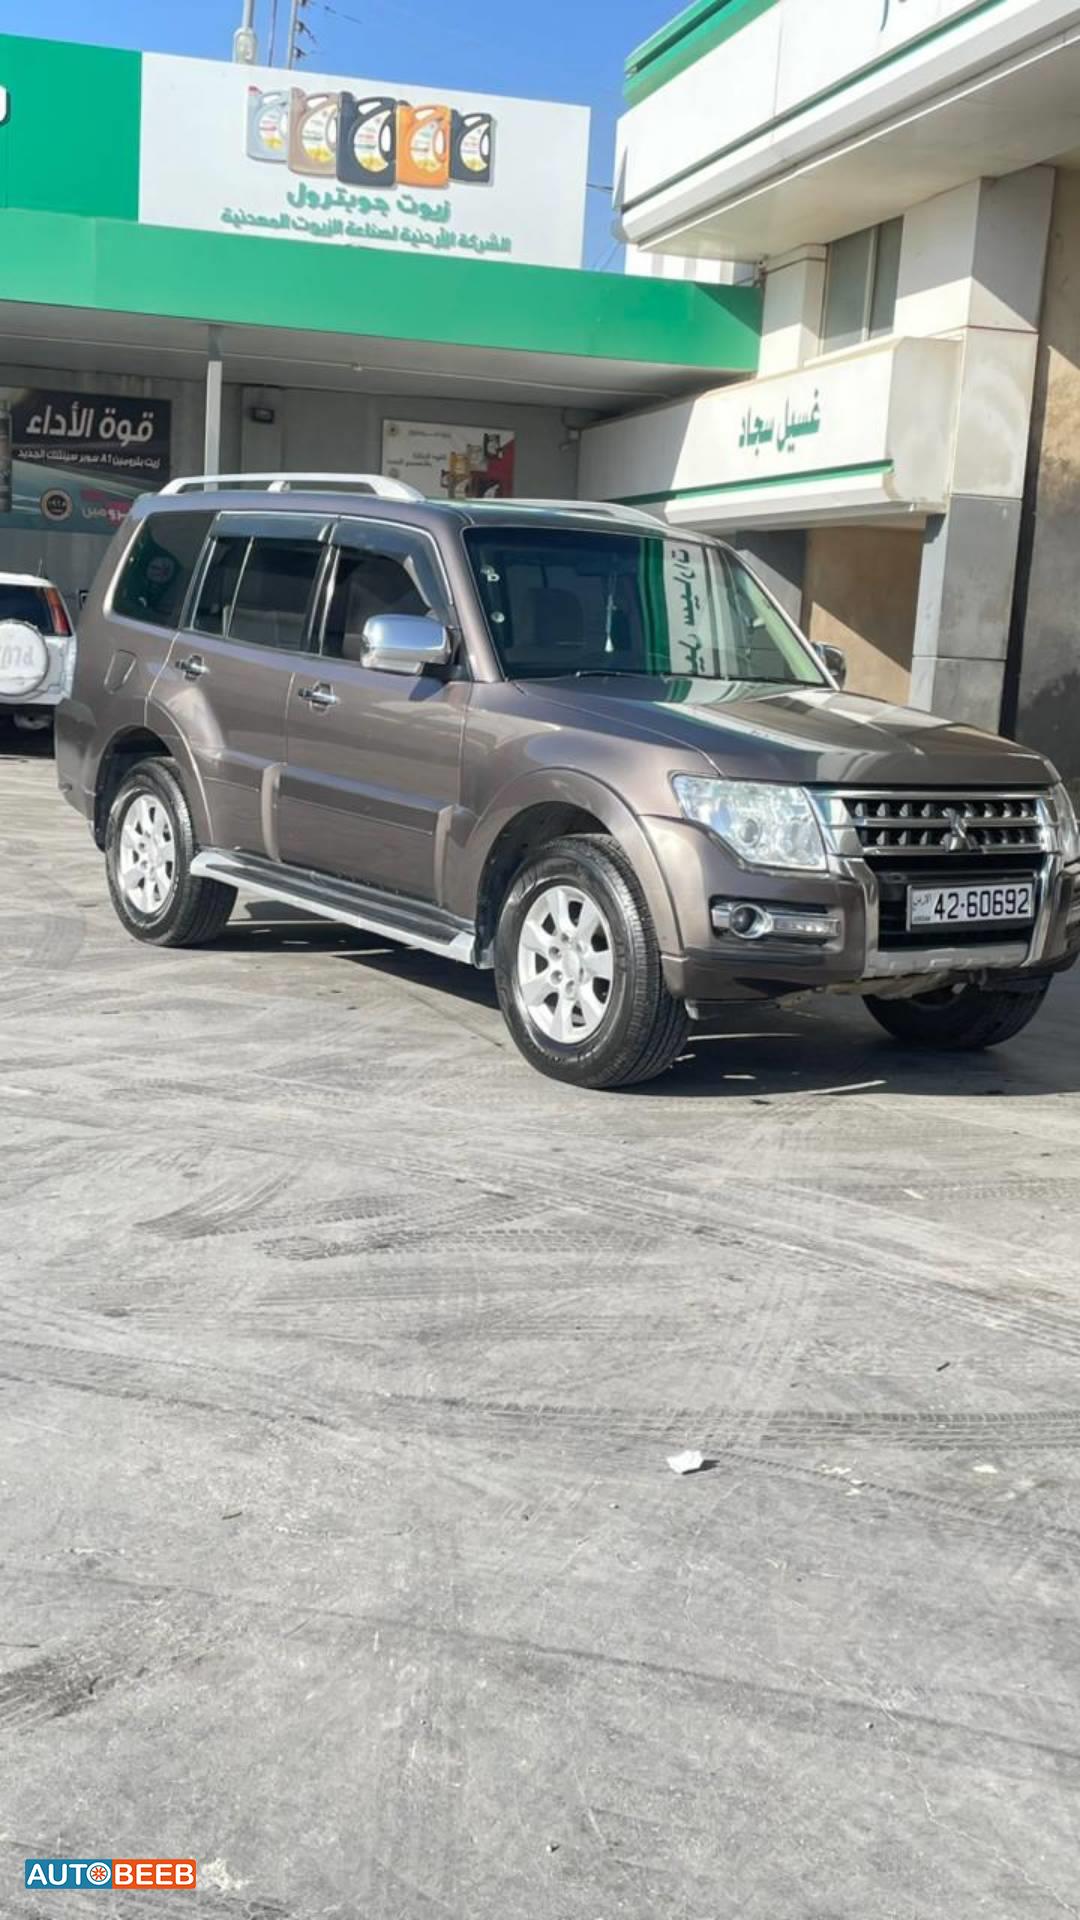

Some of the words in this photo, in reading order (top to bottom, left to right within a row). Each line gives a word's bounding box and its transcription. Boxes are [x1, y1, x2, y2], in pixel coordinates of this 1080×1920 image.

[287, 182, 390, 217] جوبترول
[396, 194, 451, 223] زيوت
[221, 207, 290, 229] المعدنية
[291, 216, 343, 238] الزيوت
[345, 221, 398, 241] لصناعة
[400, 227, 457, 249] الأردنية
[458, 232, 512, 254] الشركة
[26, 401, 95, 439] الأداء
[100, 407, 154, 447] قوة
[738, 405, 775, 456] سجاد
[776, 388, 820, 453] غسيل
